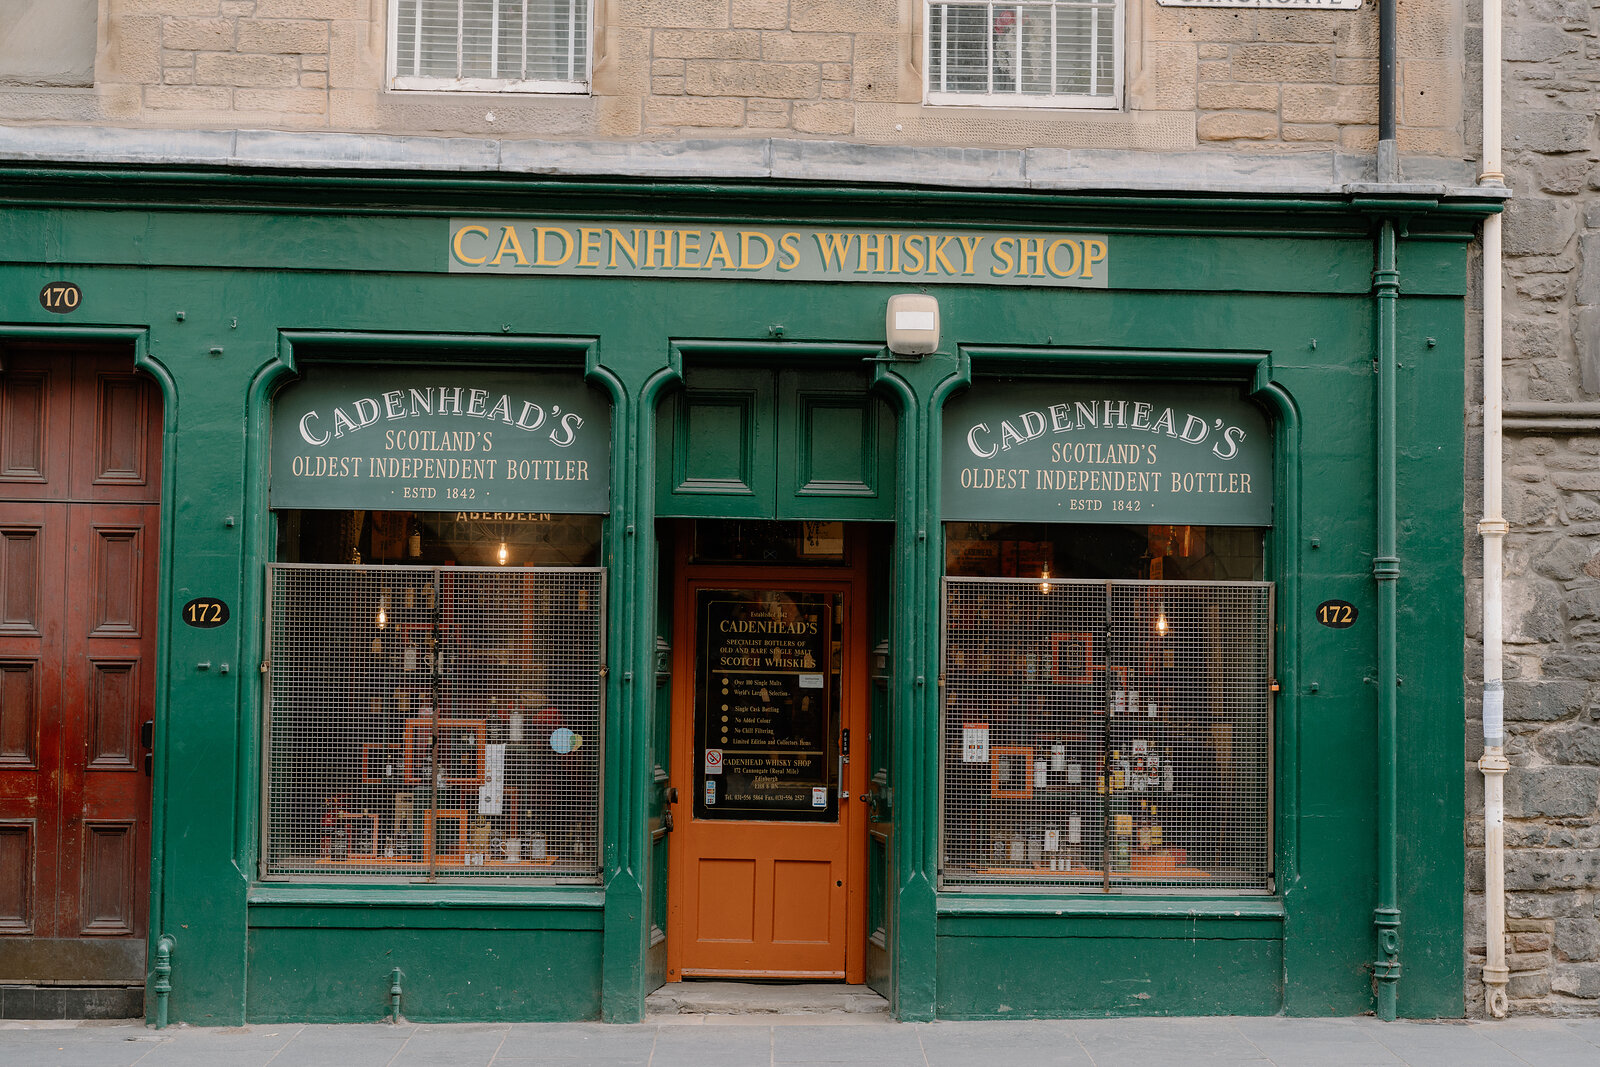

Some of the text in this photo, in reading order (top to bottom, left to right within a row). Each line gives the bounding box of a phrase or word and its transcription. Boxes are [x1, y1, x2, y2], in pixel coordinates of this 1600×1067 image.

[451, 225, 1107, 279] CADENHEADS WHISKY SHOP
[43, 287, 79, 307] 170
[299, 387, 584, 447] CADENHEAD'S
[967, 400, 1247, 460] CADENHEAD'S
[385, 430, 493, 452] SCOTLAND'S
[1051, 443, 1157, 465] SCOTLAND'S
[292, 456, 589, 481] OLDEST INDEPENDENT BOTTLER
[961, 468, 1252, 494] OLDEST INDEPENDENT BOTTLER
[404, 487, 476, 499] ESTD 1842
[1070, 499, 1141, 512] ESTD 1842
[188, 603, 222, 622] 172
[1319, 605, 1353, 623] 172
[720, 620, 818, 634] CADENHEAD'S
[720, 657, 760, 667] SCOTCH
[765, 759, 792, 767] WHISKY
